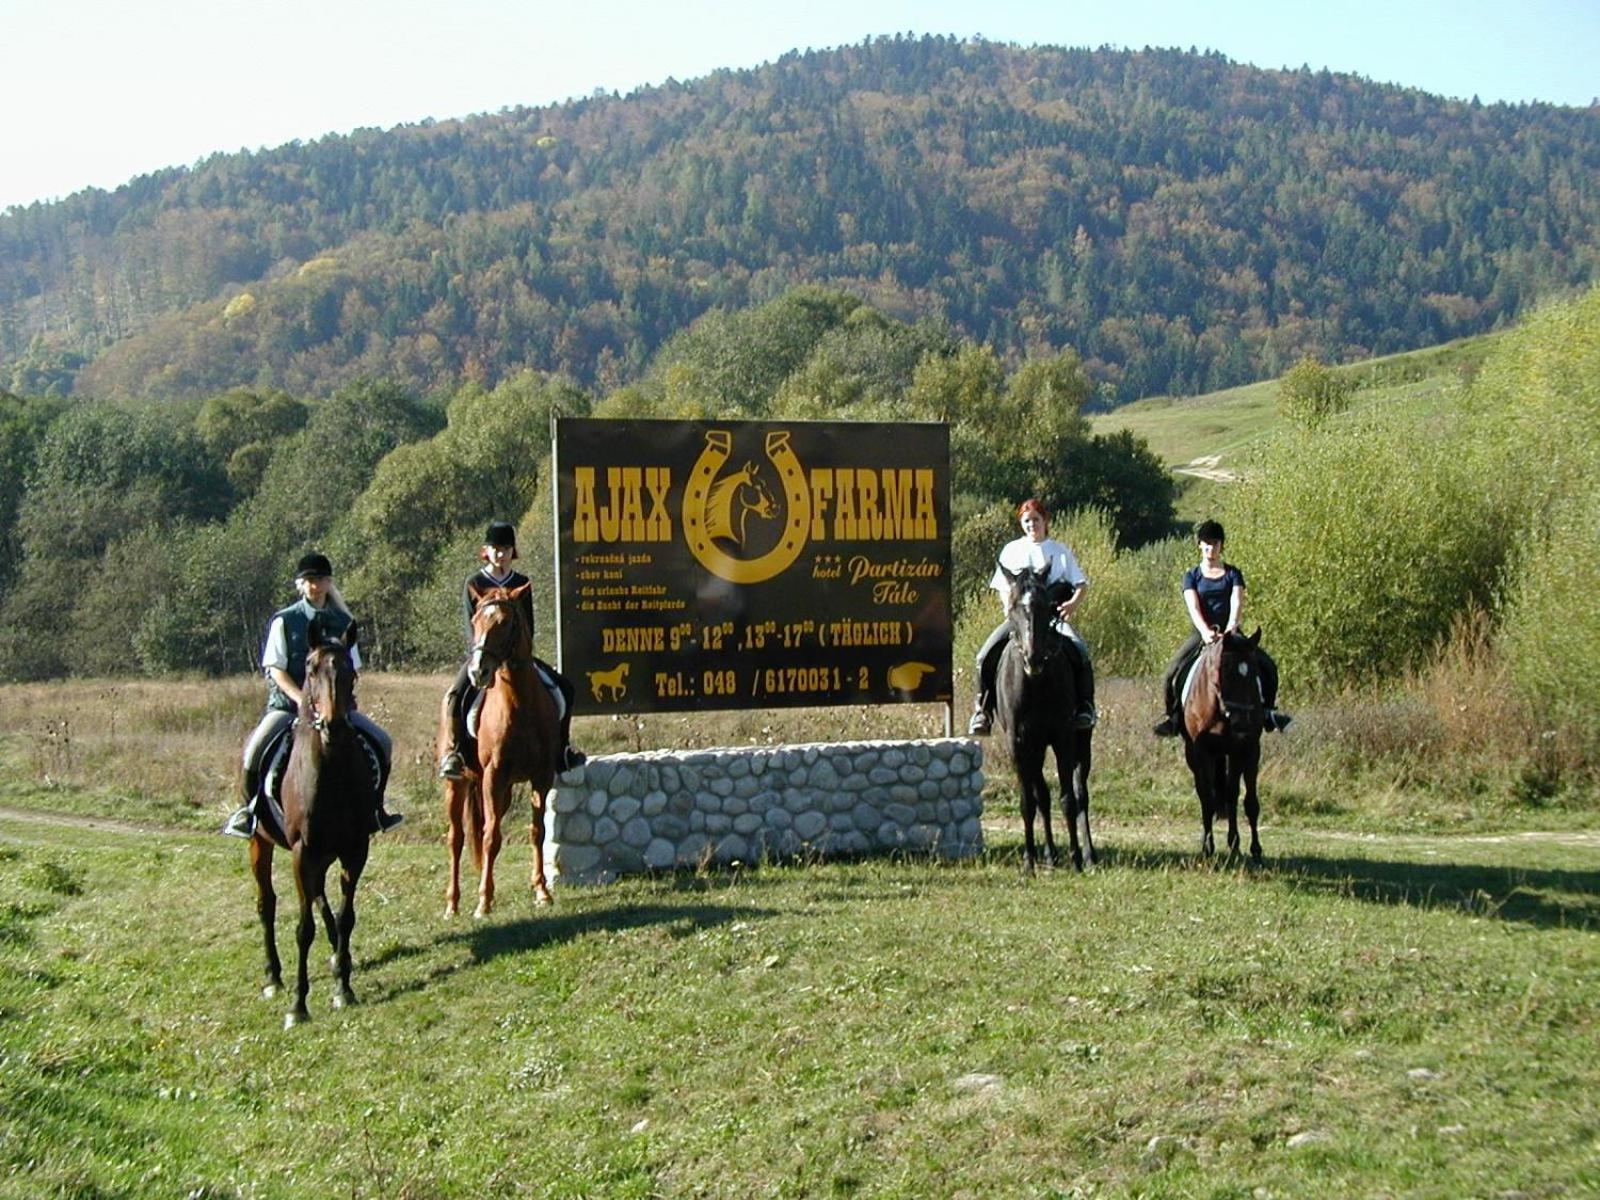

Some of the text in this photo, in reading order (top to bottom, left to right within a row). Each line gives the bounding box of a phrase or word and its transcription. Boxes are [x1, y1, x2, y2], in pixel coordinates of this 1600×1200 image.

[573, 466, 672, 543] AJAX
[810, 468, 938, 541] FARMA
[812, 555, 943, 586] hotel Partizán
[581, 586, 595, 596] die
[581, 601, 595, 611] die
[602, 626, 665, 653] DENNE
[655, 671, 695, 698] Tel.:
[703, 670, 737, 696] 048
